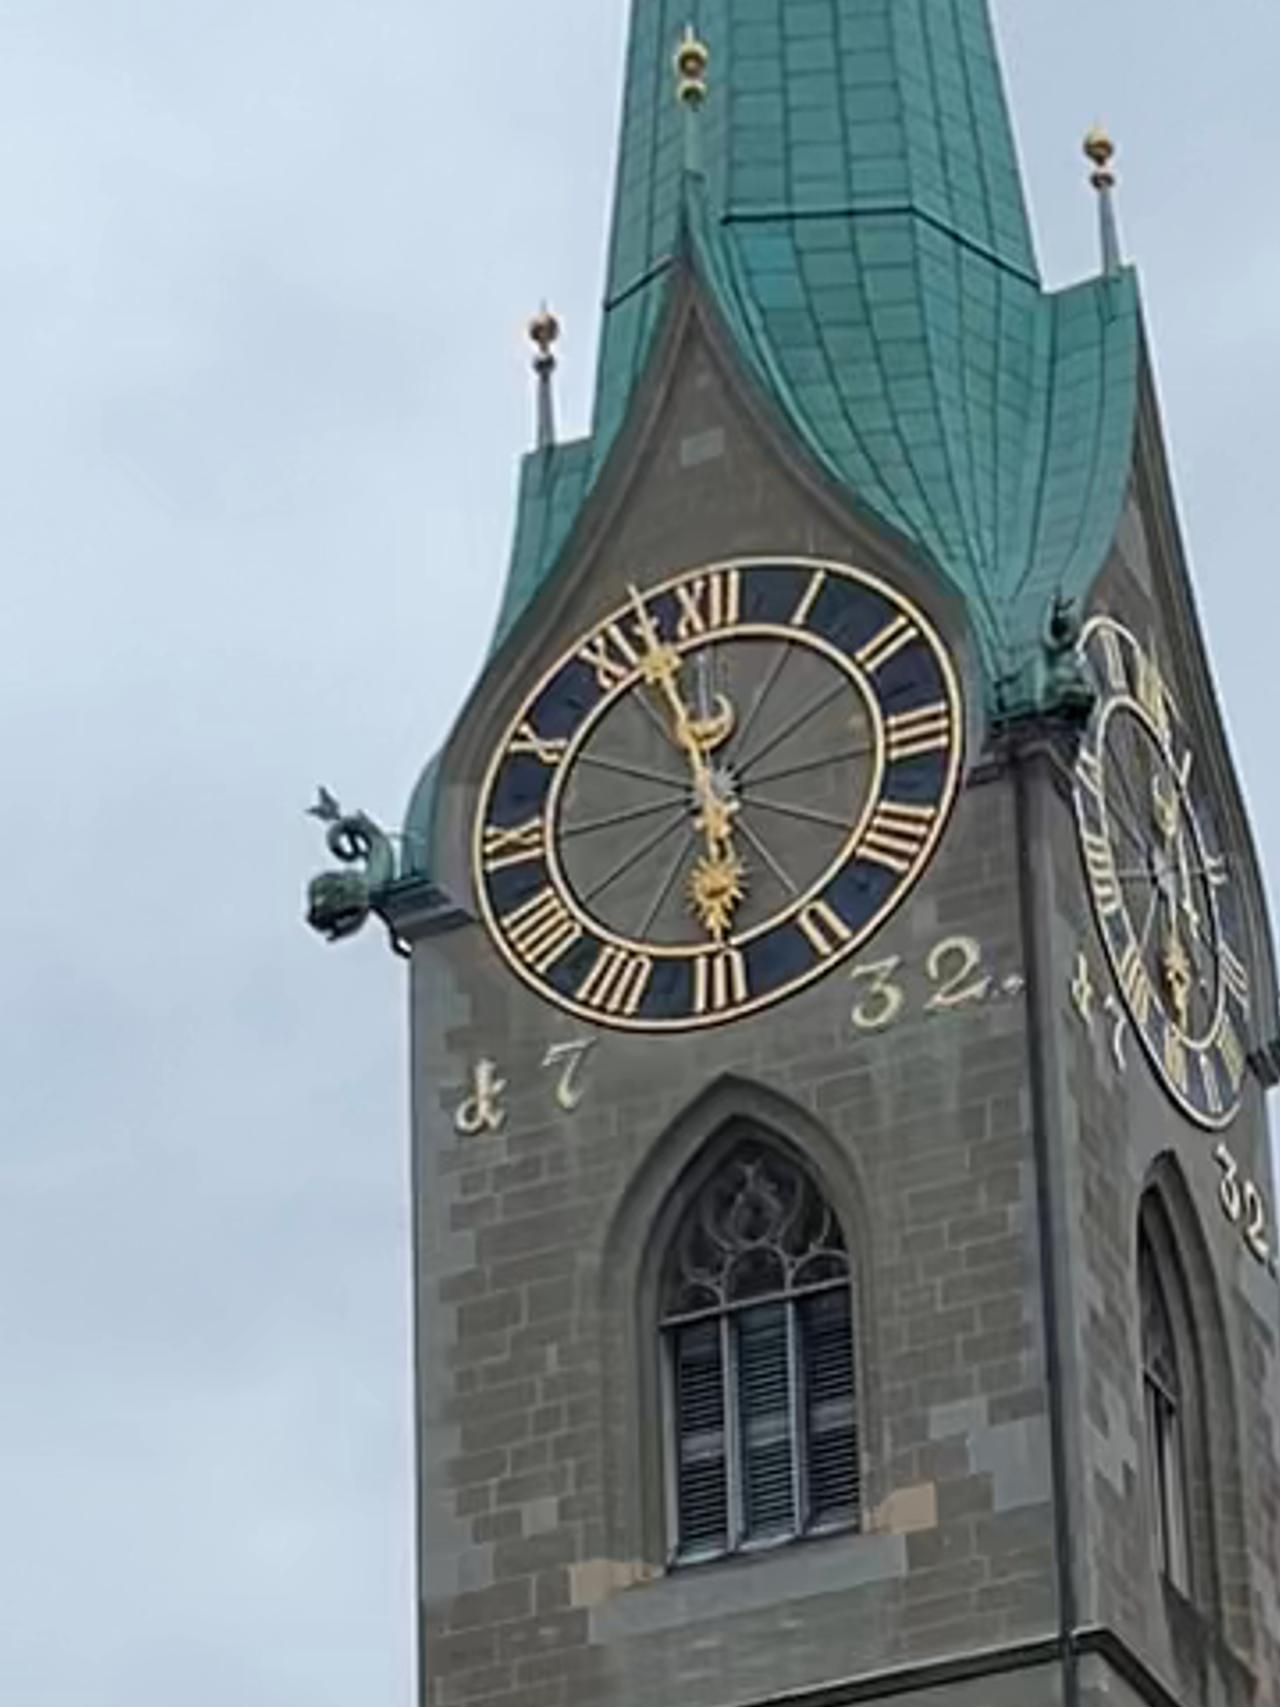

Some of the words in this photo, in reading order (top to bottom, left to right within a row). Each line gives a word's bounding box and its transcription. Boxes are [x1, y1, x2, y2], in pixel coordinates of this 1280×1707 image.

[676, 569, 740, 638] XII
[791, 569, 826, 626] I
[855, 614, 919, 673] II
[886, 702, 950, 761] III
